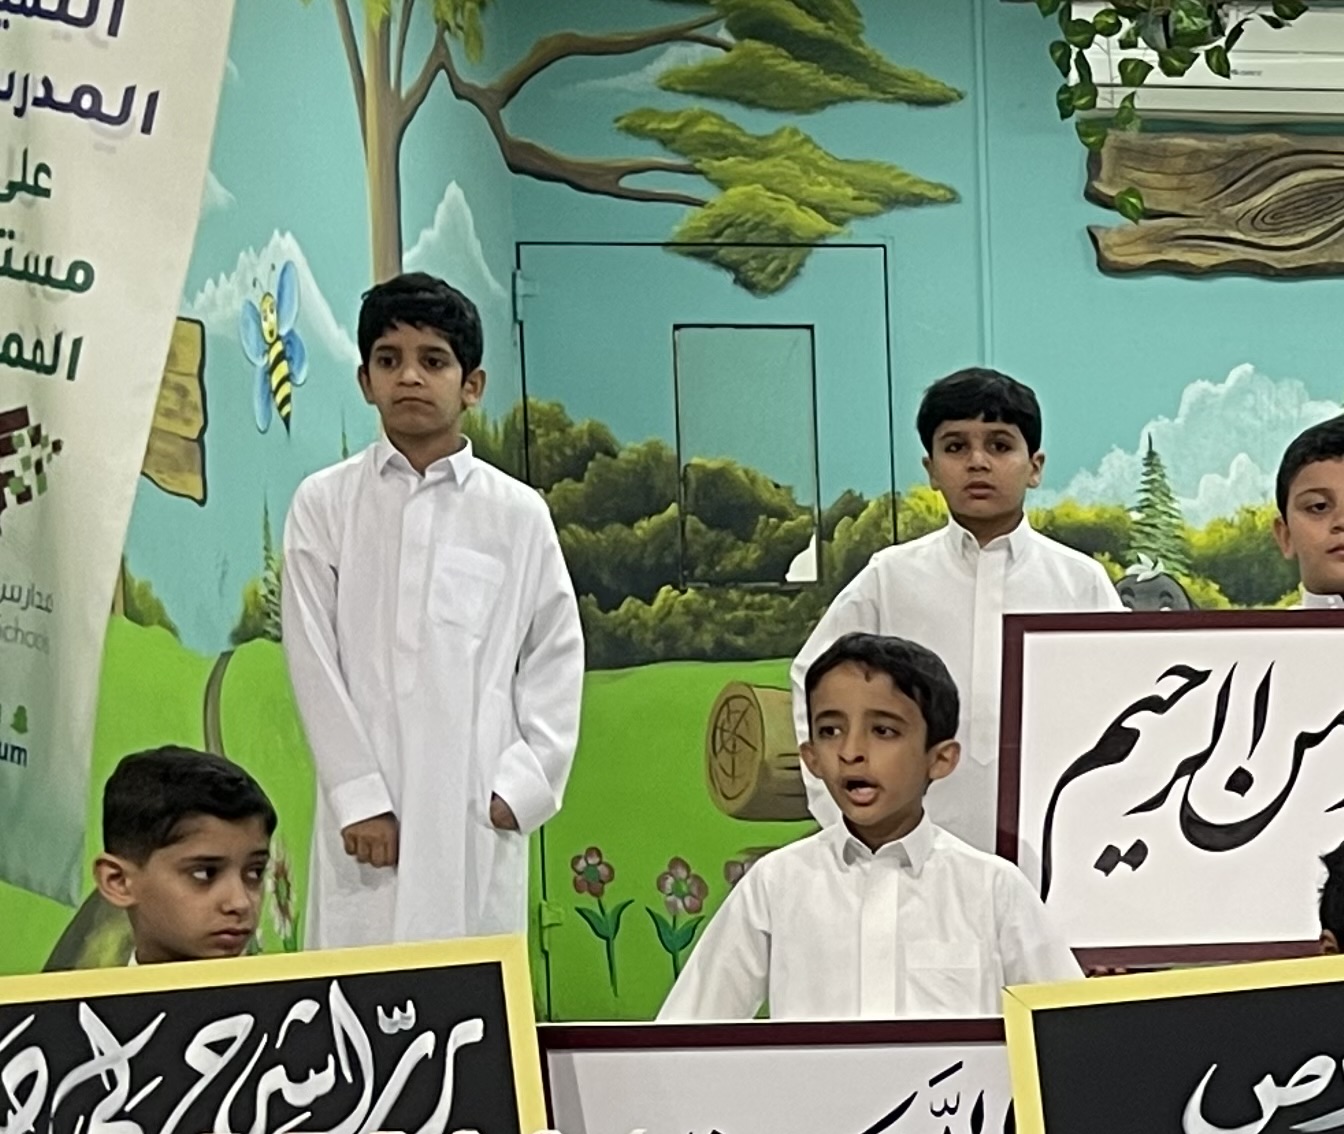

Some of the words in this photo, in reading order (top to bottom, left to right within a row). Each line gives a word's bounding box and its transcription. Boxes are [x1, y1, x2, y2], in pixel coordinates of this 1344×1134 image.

[0, 228, 95, 294] مست
[0, 330, 83, 381] المم
[1041, 660, 1276, 902] الرحيم
